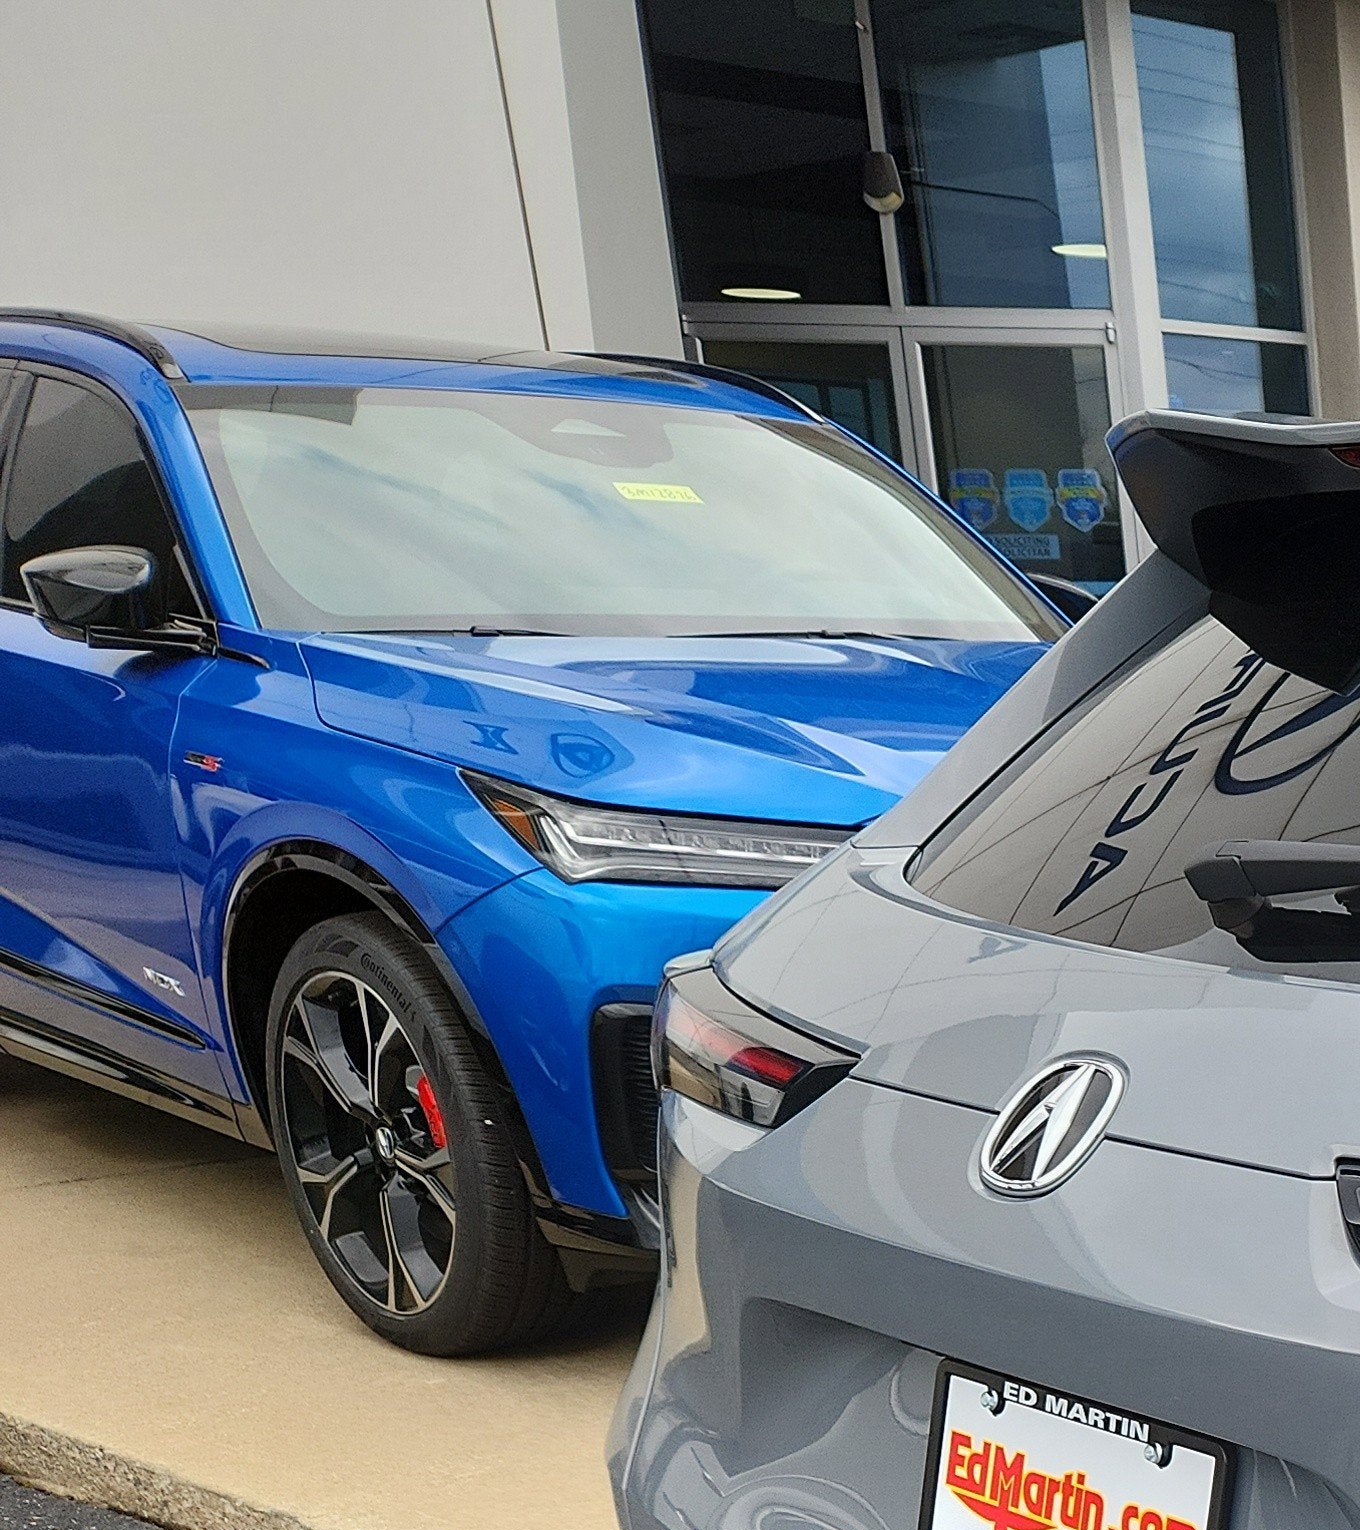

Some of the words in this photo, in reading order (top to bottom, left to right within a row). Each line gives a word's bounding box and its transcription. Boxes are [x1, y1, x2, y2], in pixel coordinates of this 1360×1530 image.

[360, 953, 412, 1013] Continental
[1002, 1380, 1038, 1408] ED
[1045, 1394, 1151, 1443] MARTIN
